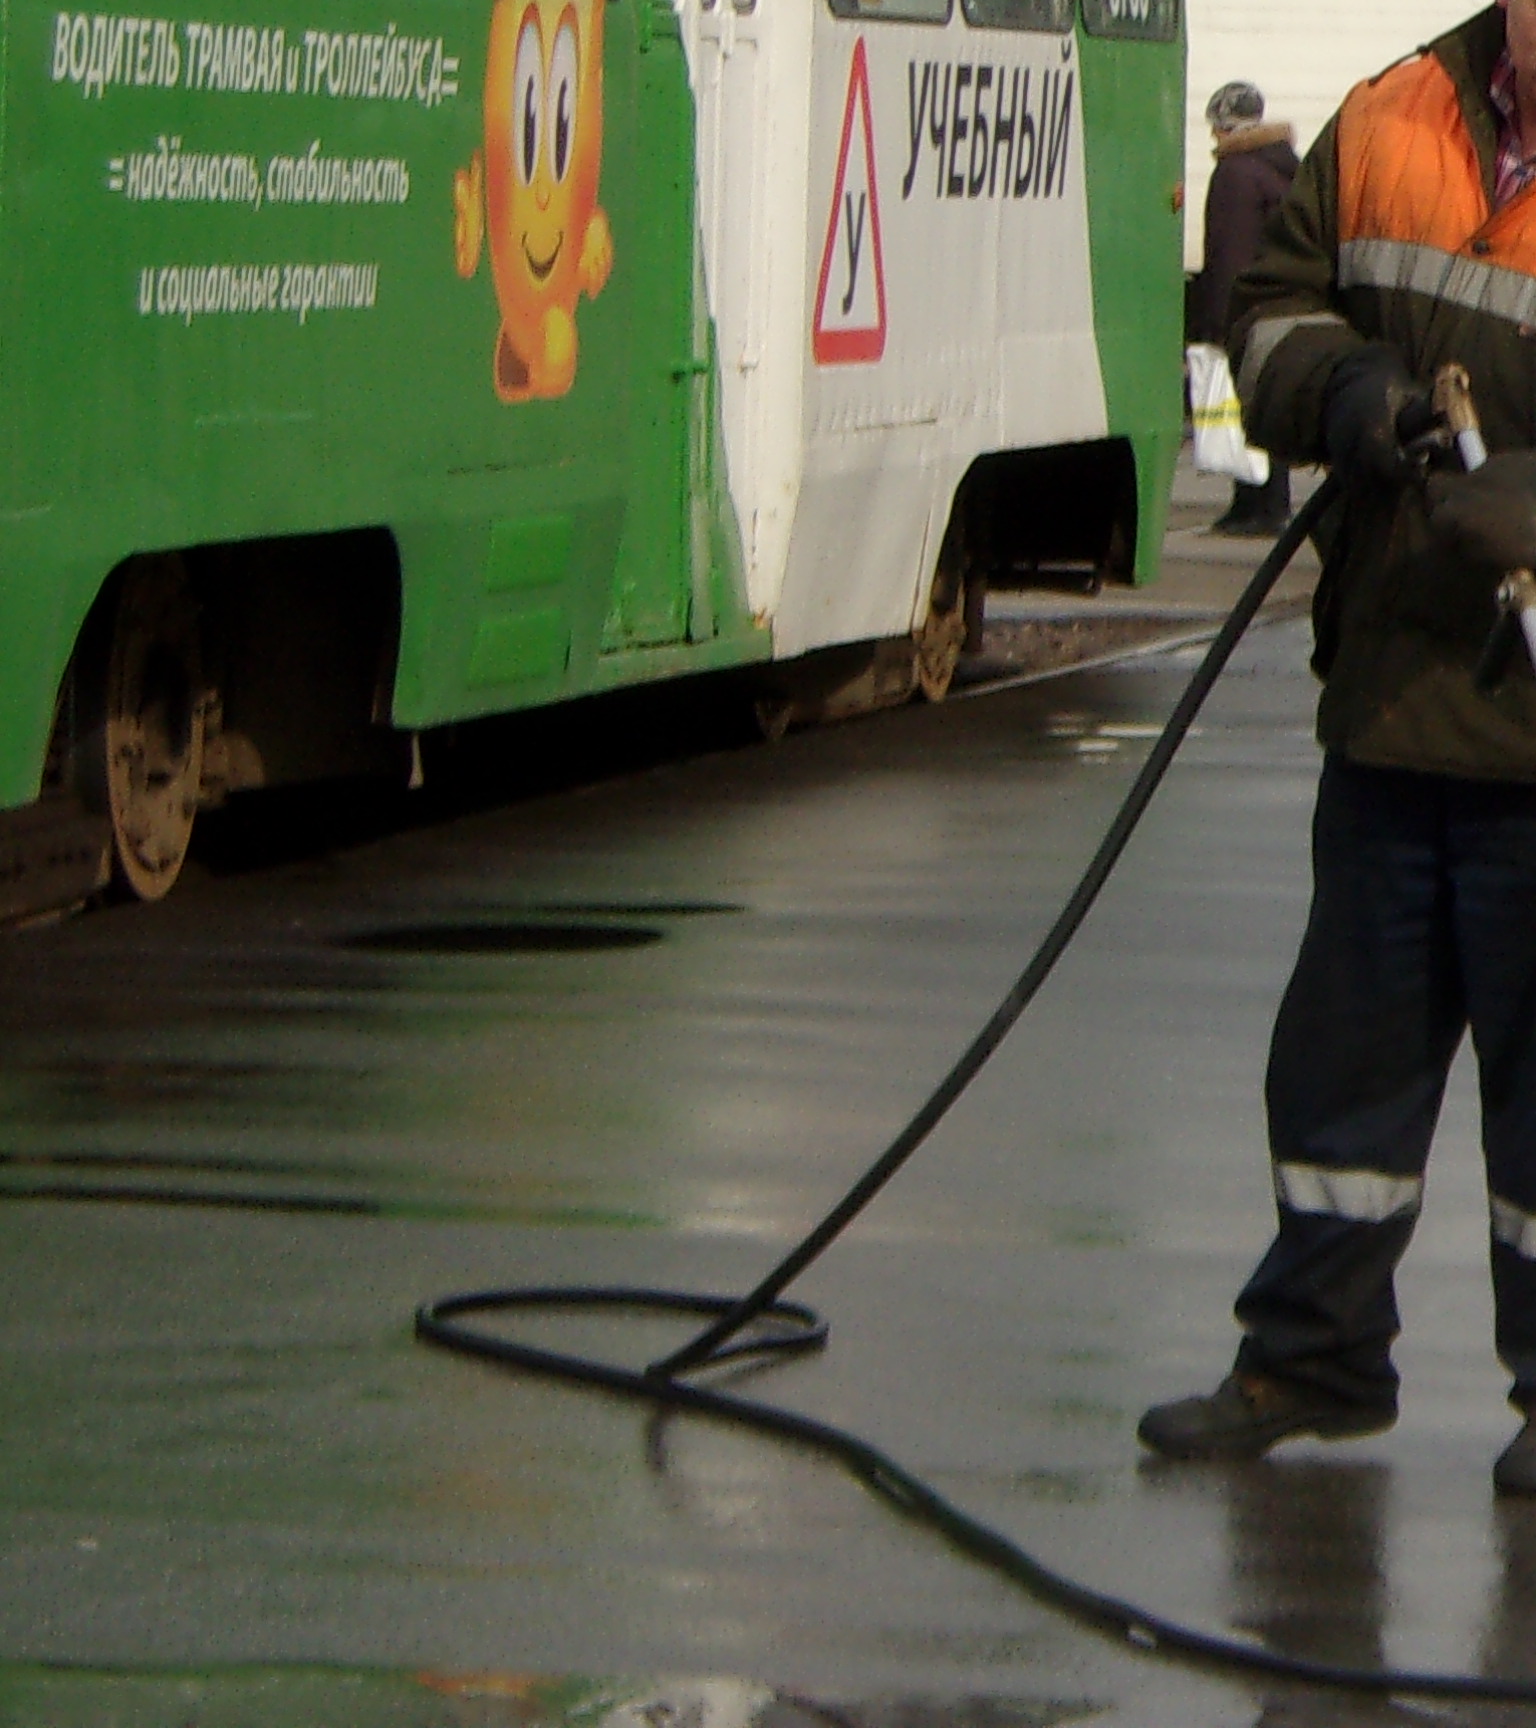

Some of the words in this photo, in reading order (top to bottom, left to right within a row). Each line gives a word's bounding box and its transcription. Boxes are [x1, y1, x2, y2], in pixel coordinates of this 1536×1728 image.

[52, 12, 181, 100] ВОДИТЕЛЬ
[185, 23, 285, 94] ТРАМВАЯ
[902, 39, 1075, 200] УЧЕБНЫЙ
[265, 138, 410, 204] стабильность
[156, 265, 281, 328] социальные
[281, 263, 379, 327] гарантии
[841, 190, 867, 316] У
